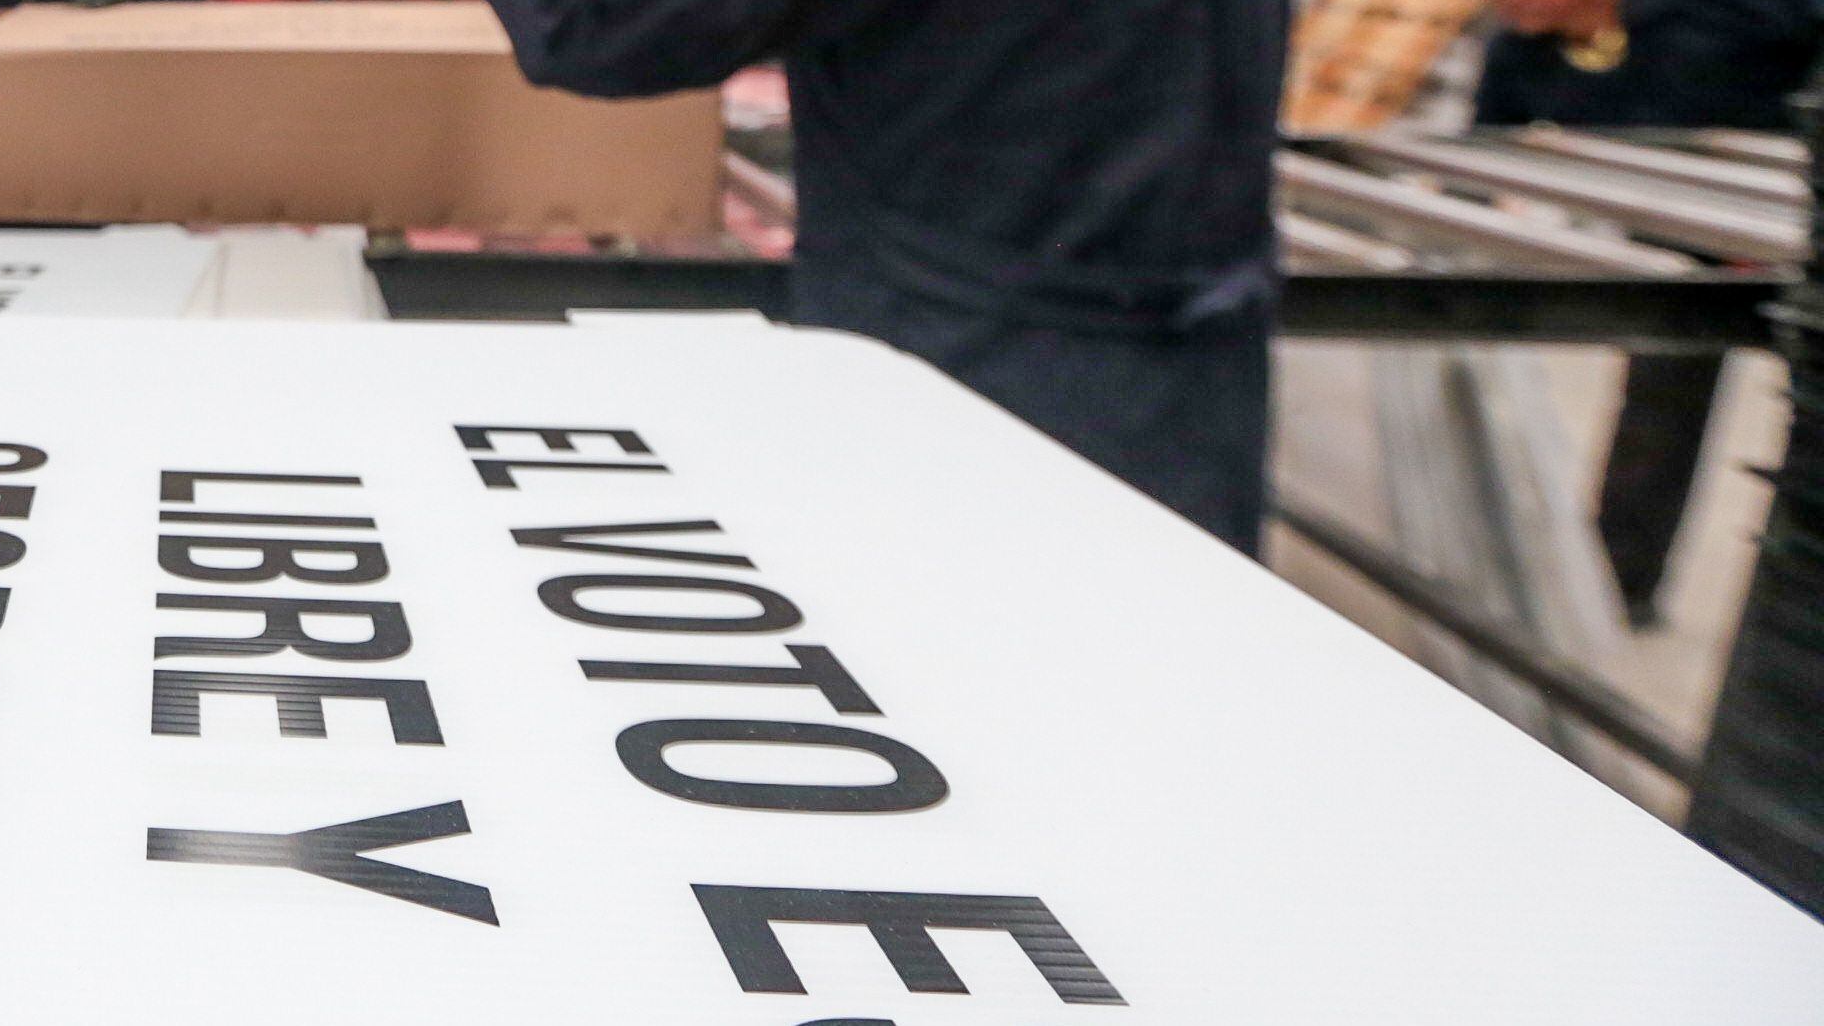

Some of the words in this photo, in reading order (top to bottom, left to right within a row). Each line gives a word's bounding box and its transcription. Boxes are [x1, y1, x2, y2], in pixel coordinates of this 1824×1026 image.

[453, 424, 671, 489] EL
[149, 469, 446, 747] LIBRE
[508, 519, 951, 814] VOTO
[146, 798, 501, 928] Y
[688, 882, 1130, 1026] E
